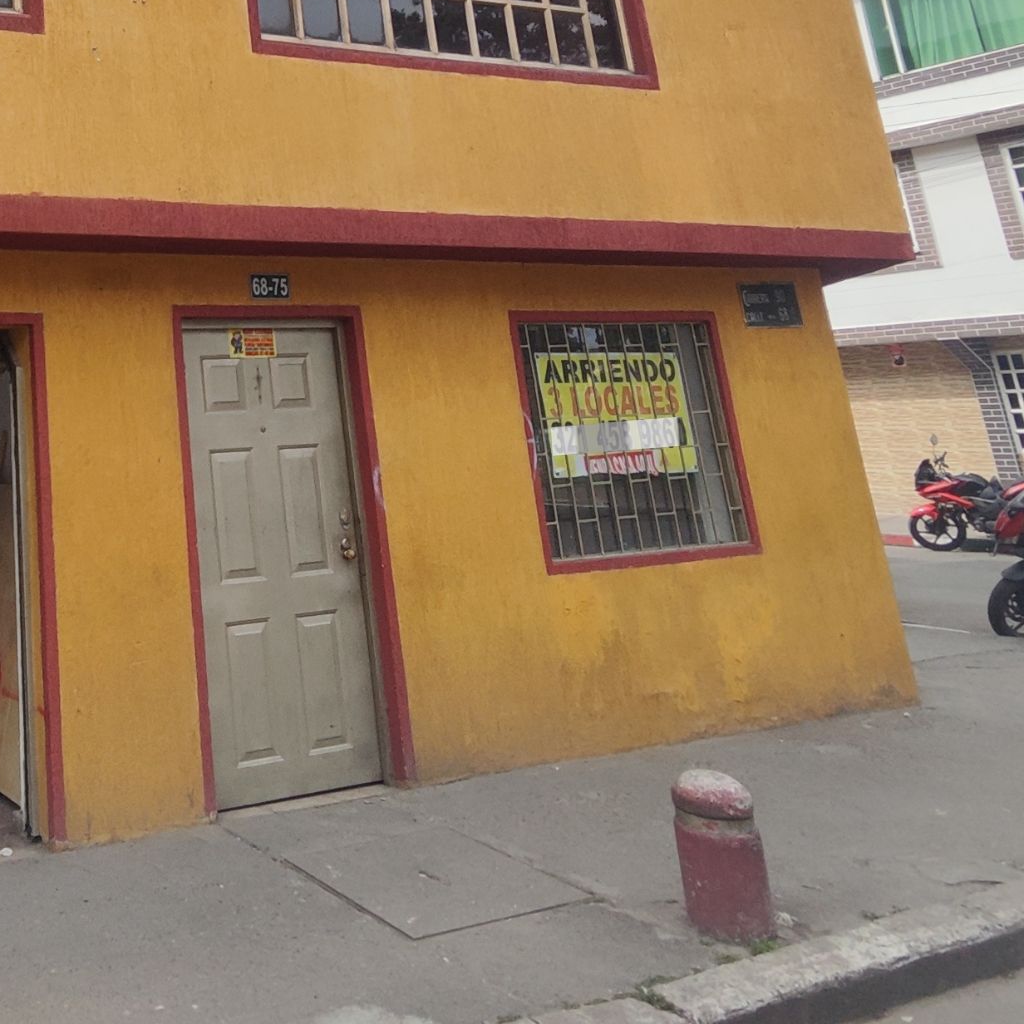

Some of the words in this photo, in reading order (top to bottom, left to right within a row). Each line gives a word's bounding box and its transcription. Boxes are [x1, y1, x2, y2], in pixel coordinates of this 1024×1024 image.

[252, 277, 288, 296] 68-75
[544, 358, 676, 384] ARRIENDO
[548, 386, 564, 417] 3
[569, 384, 680, 417] LOCALES
